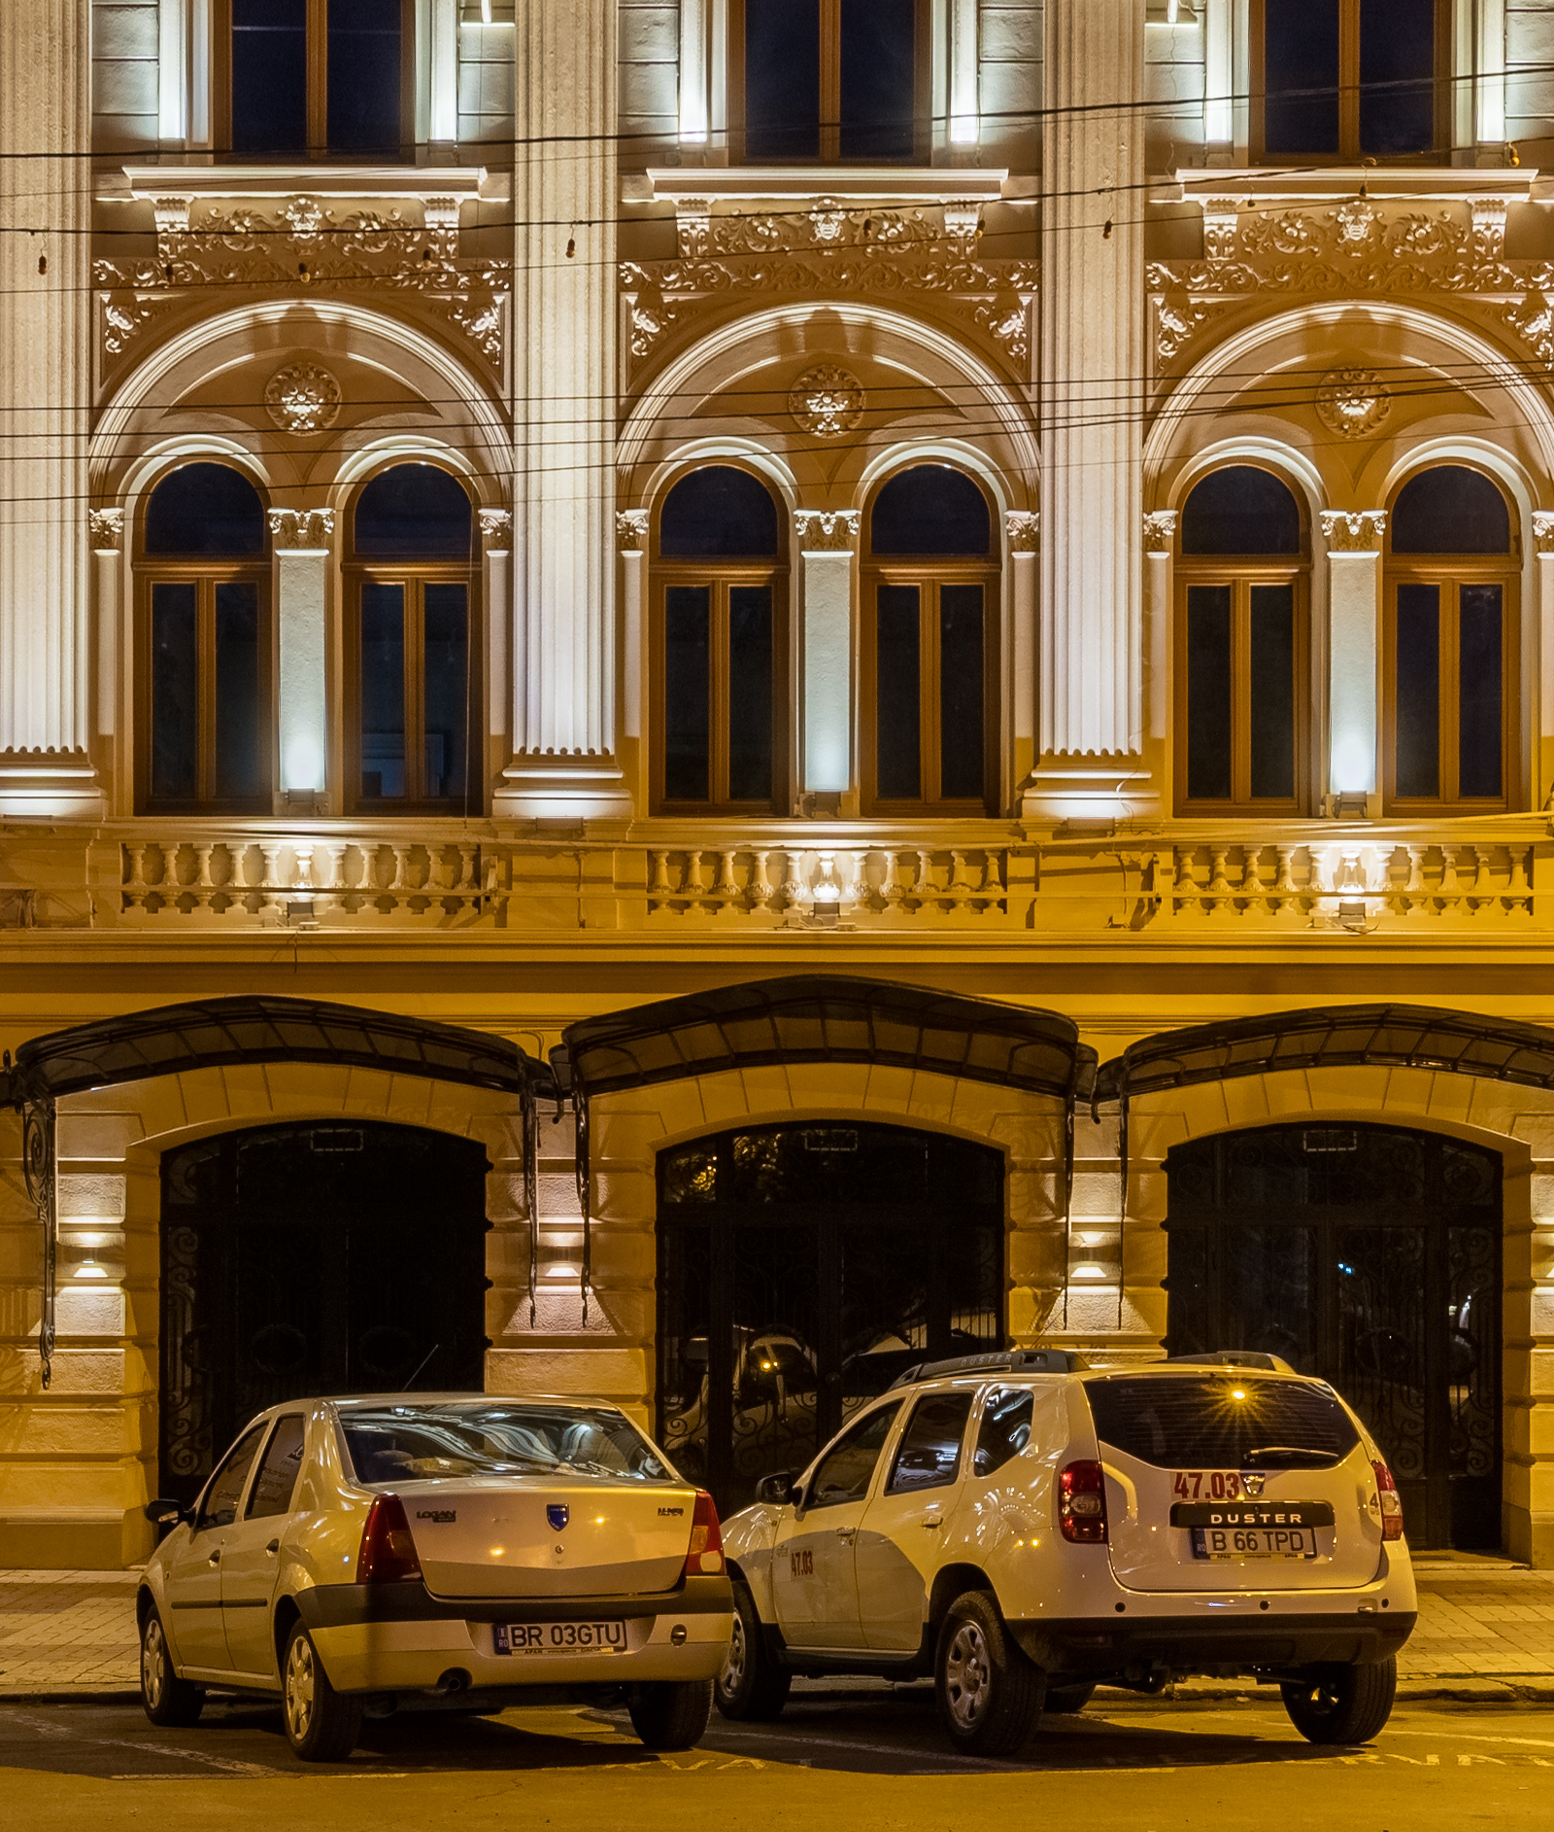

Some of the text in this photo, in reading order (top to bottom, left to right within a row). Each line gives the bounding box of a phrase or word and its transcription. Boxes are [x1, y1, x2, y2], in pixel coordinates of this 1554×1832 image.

[961, 1354, 1012, 1366] DUSTER
[1174, 1472, 1240, 1499] 47.03
[1369, 1493, 1379, 1509] 4
[1210, 1513, 1302, 1524] DUSTER
[1212, 1531, 1304, 1552] B 66 TPD
[791, 1550, 813, 1576] 47.03
[498, 1639, 508, 1647] RO
[510, 1626, 543, 1647] BR
